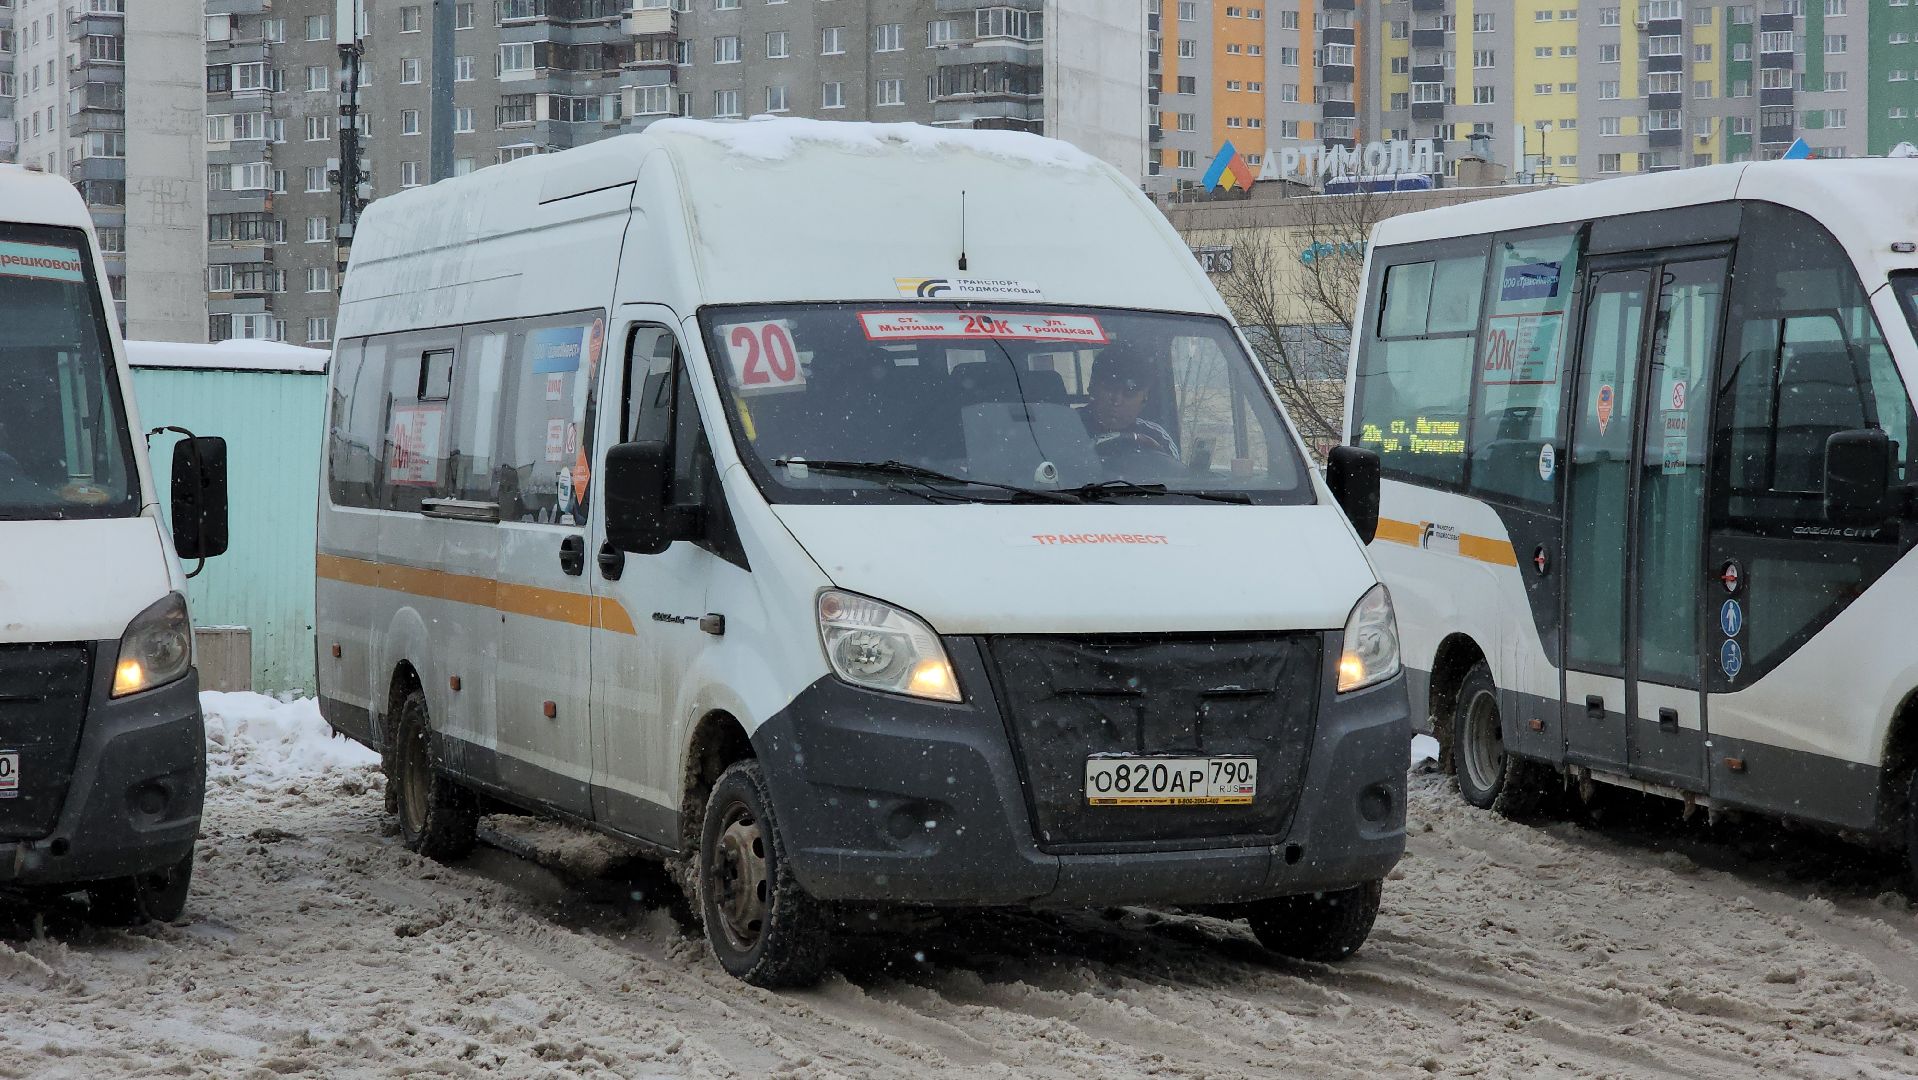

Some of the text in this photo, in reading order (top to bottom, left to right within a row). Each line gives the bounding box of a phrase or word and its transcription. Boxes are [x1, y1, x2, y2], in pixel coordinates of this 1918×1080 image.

[1258, 139, 1434, 181] АРТИМОЛЛ
[956, 279, 1020, 287] ТРАНСПОРТ
[959, 285, 1041, 295] ПОДМОСКОВЬЯ
[878, 324, 945, 332] Мытищи
[1042, 319, 1067, 327] ул.
[1022, 324, 1095, 336] Троицкая
[731, 323, 796, 386] 20
[1667, 418, 1686, 432] ВХОД
[1032, 534, 1169, 545] ТРАНСИНВЕСТ
[1095, 761, 1250, 793] О820АР 790
[1219, 785, 1239, 793] RUS
